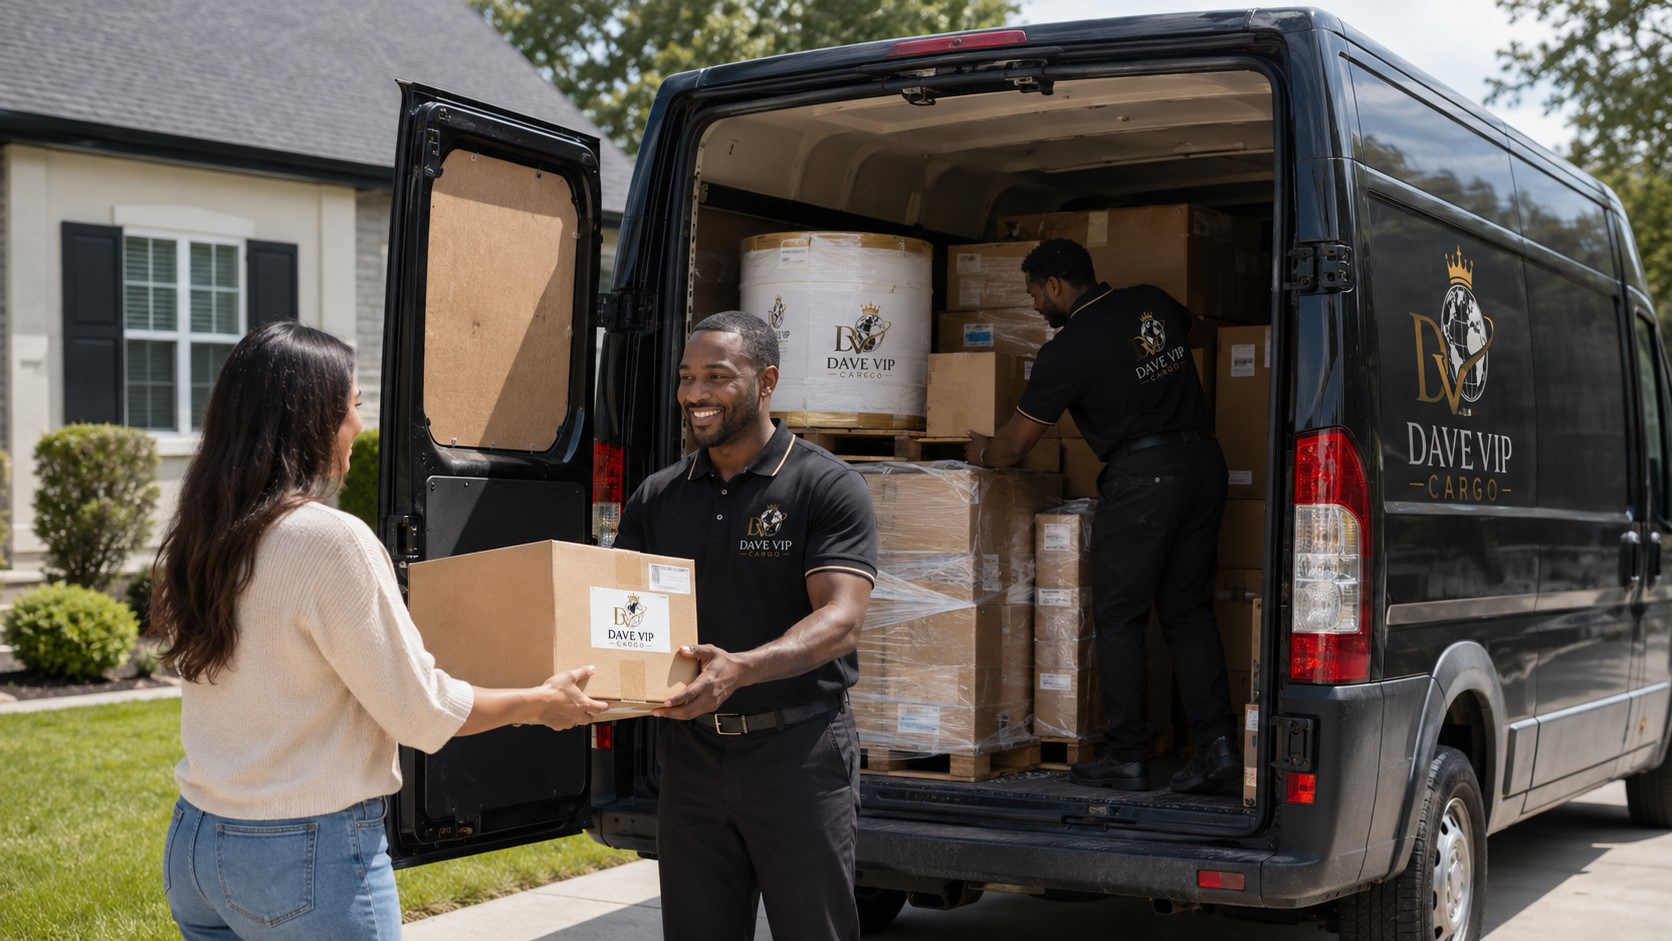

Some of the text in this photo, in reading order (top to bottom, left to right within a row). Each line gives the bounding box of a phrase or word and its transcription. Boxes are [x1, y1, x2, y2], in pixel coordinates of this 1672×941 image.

[827, 357, 895, 371] DAVE VIP
[1135, 346, 1184, 379] DAVE VIP
[1406, 421, 1512, 474] DAVE VIP
[1428, 474, 1498, 502] CARGO
[740, 540, 792, 551] DAVE VIP
[608, 629, 654, 642] DAVE VIP
